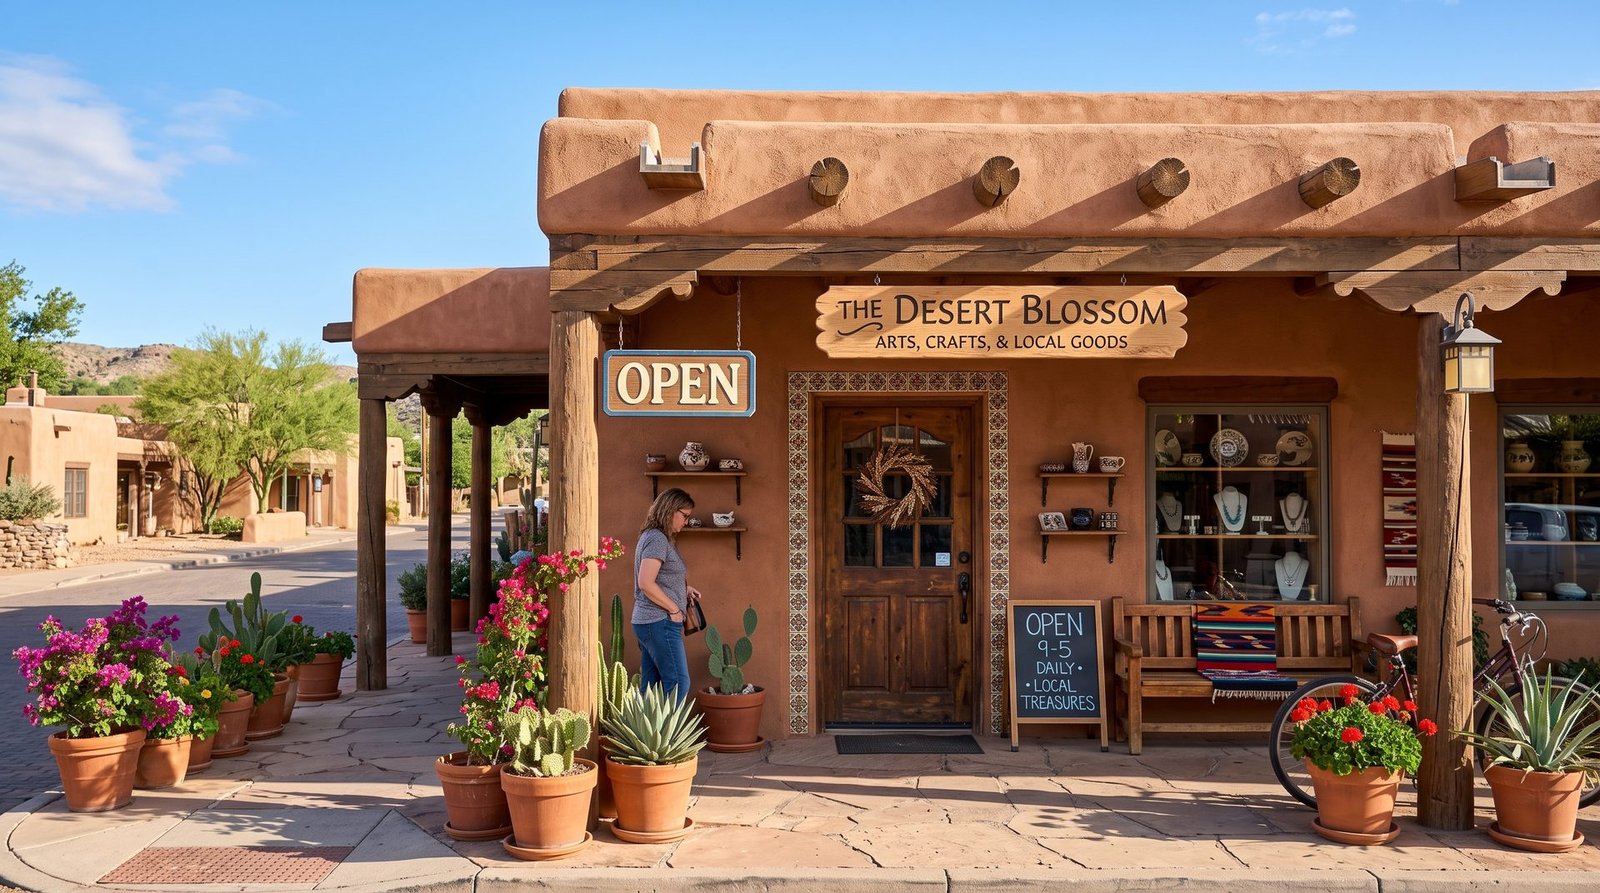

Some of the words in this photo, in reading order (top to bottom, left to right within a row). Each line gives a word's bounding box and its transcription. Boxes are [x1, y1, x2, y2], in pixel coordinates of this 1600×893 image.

[838, 299, 882, 319] THE
[894, 294, 1010, 325] DESERT
[1021, 294, 1167, 325] BLOSSOM
[875, 335, 920, 351] ARTS,
[926, 335, 991, 351] CRAFTS,
[997, 335, 1009, 349] &
[1015, 335, 1066, 349] LOCAL
[1071, 335, 1128, 349] GOODS
[617, 362, 741, 405] OPEN
[1026, 612, 1083, 636] OPEN
[1038, 640, 1072, 658] 9-5
[1036, 661, 1075, 675] DAILY
[1034, 679, 1077, 693] LOCAL
[1020, 695, 1095, 711] TREASURES
